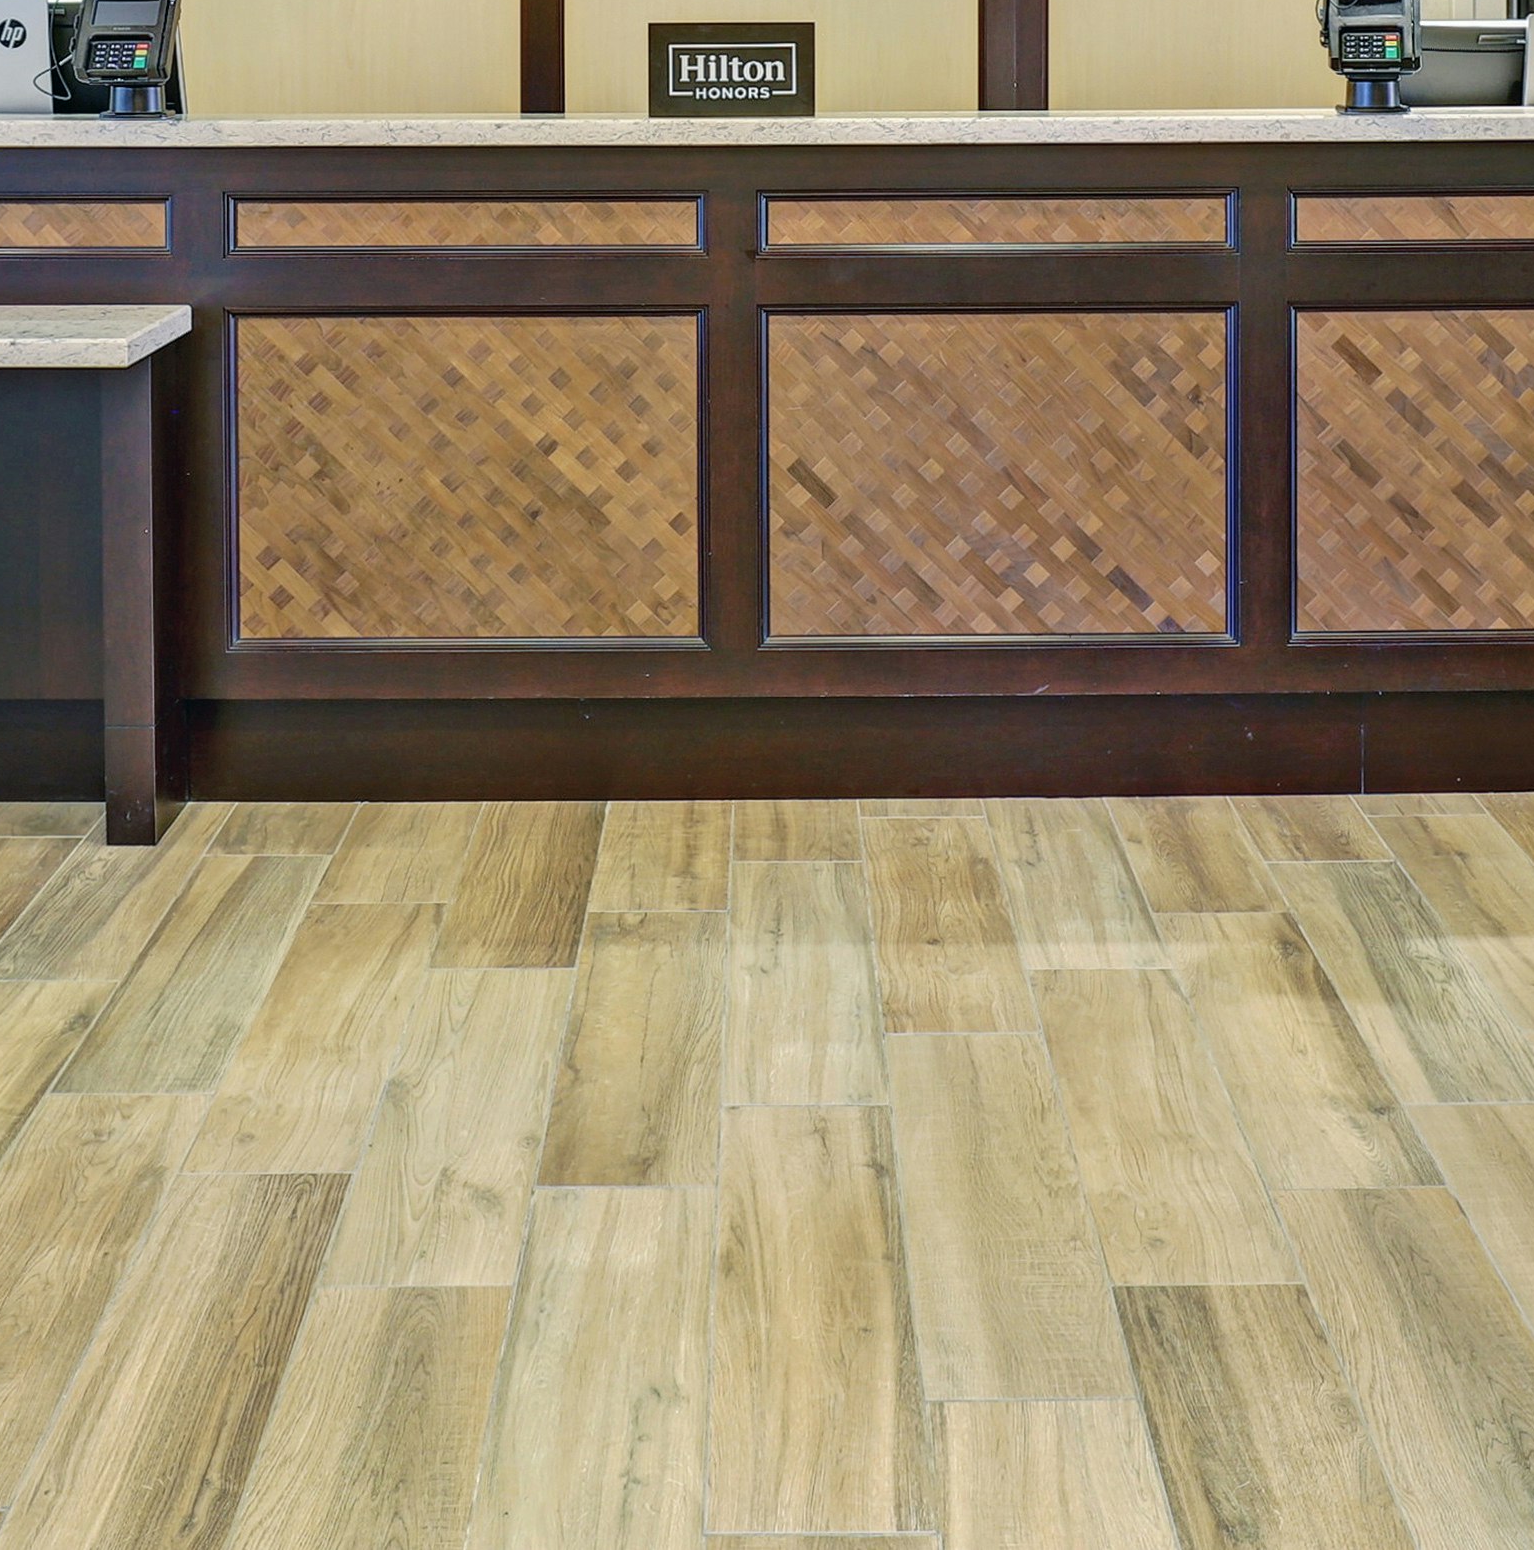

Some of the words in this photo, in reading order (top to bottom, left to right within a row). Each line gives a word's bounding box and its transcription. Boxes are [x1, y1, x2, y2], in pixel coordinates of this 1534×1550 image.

[0, 19, 24, 48] hp
[679, 54, 786, 83] Hilton
[695, 86, 771, 100] HONORS
